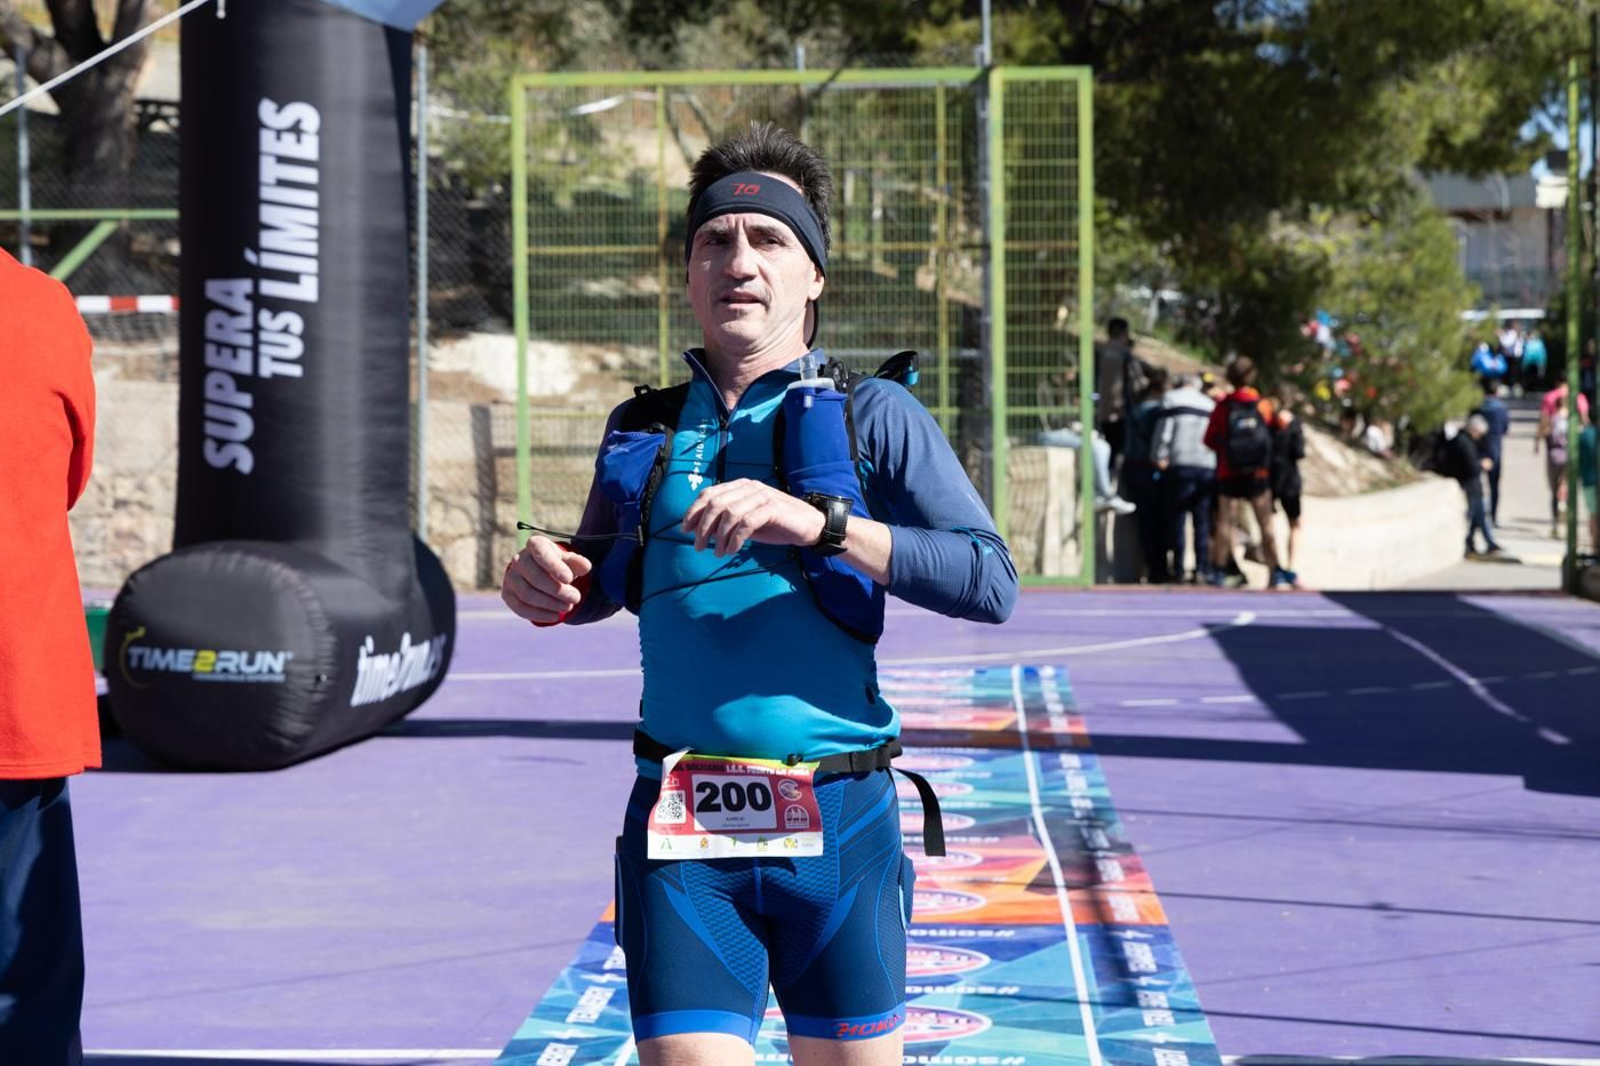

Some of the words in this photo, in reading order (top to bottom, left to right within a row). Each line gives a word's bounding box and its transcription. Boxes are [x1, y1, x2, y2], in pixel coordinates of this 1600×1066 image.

[244, 98, 321, 303] LÍMITES
[203, 278, 255, 475] SUPERA
[258, 308, 304, 378] TUS
[695, 781, 772, 813] 200
